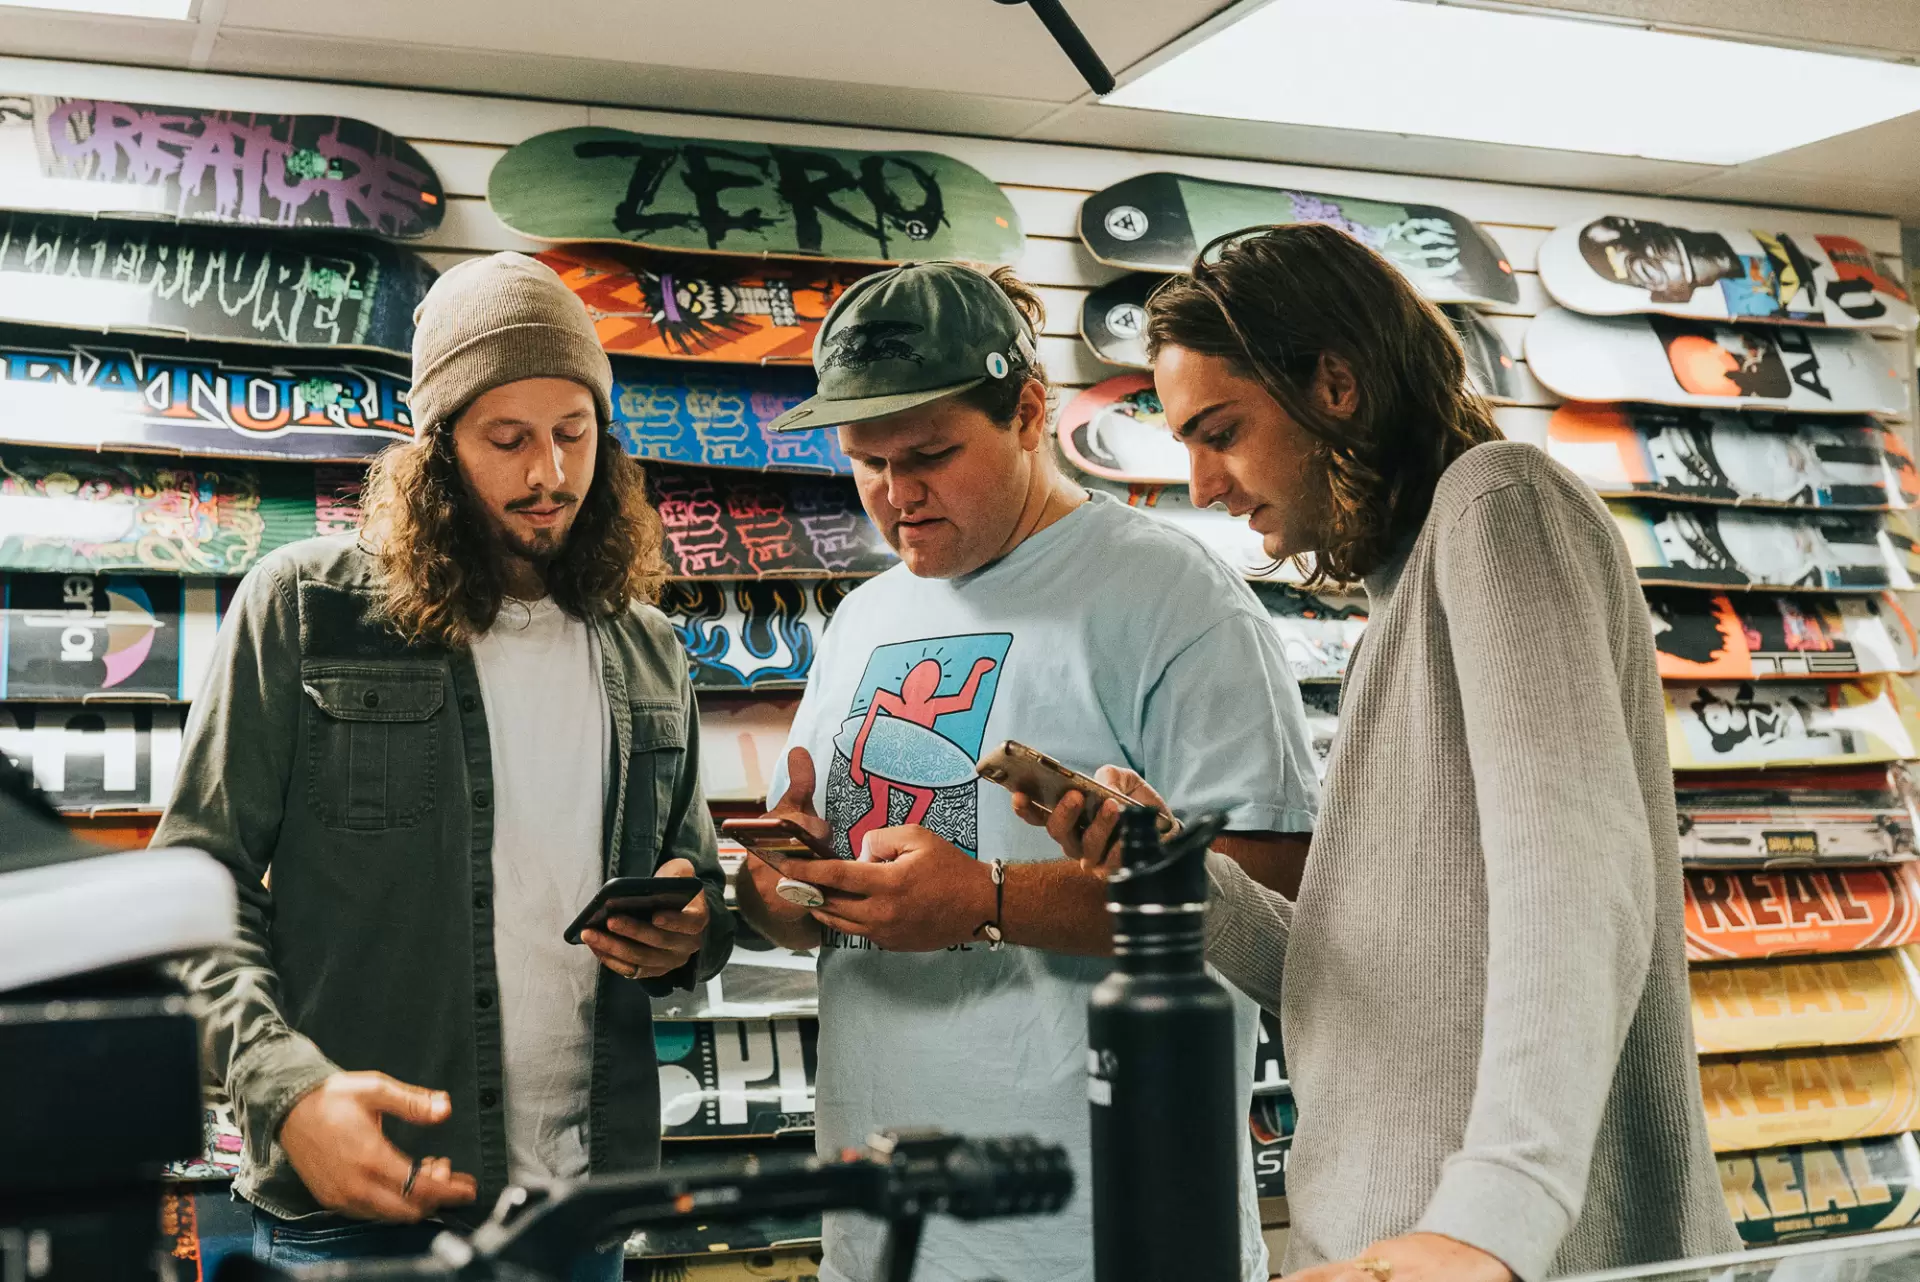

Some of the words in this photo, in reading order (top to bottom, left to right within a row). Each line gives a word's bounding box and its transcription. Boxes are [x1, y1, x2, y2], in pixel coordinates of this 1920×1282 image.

[574, 141, 949, 259] ZERO
[1685, 870, 1873, 932] REAL
[1689, 964, 1869, 1020] REAL
[1699, 1055, 1875, 1122] REAL
[1715, 1142, 1892, 1224] REAL
